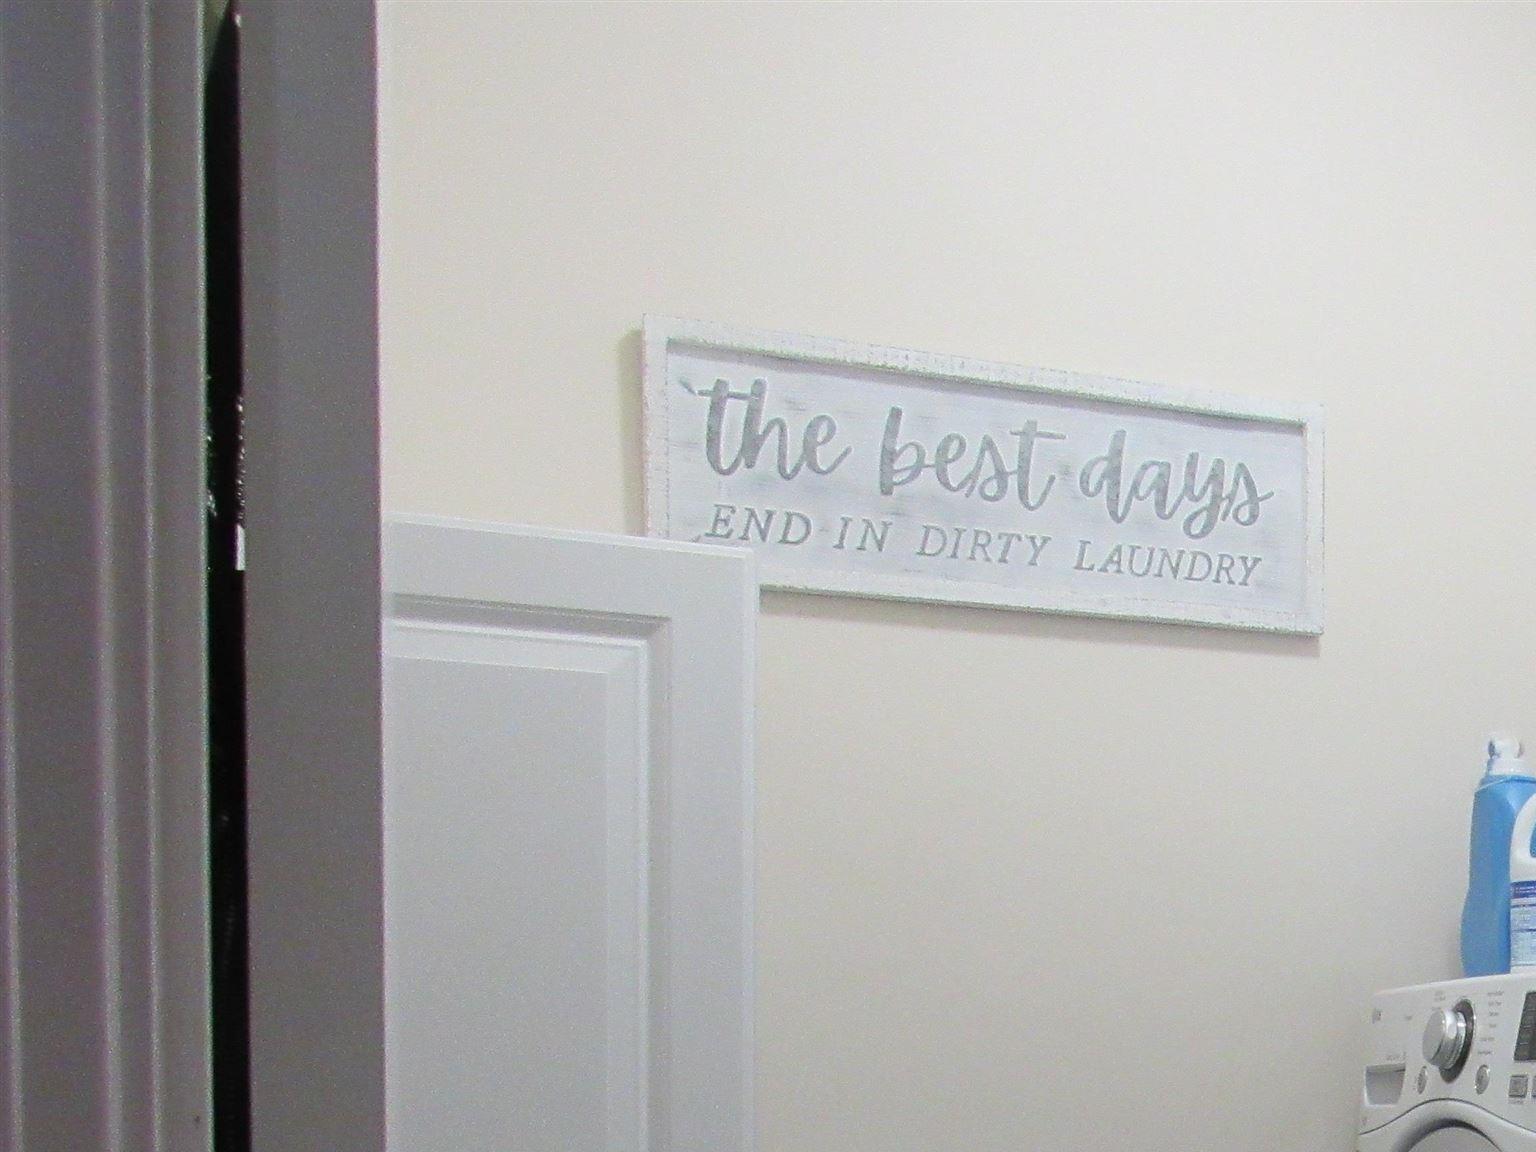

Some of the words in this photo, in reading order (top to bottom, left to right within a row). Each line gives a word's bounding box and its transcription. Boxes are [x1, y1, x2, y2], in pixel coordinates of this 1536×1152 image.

[681, 377, 852, 480] the
[879, 406, 1066, 511] best
[1079, 429, 1275, 540] days
[704, 503, 812, 546] END
[832, 515, 893, 553] IN
[915, 523, 1051, 568] DIRTY
[1073, 540, 1262, 587] LAUNDRY
